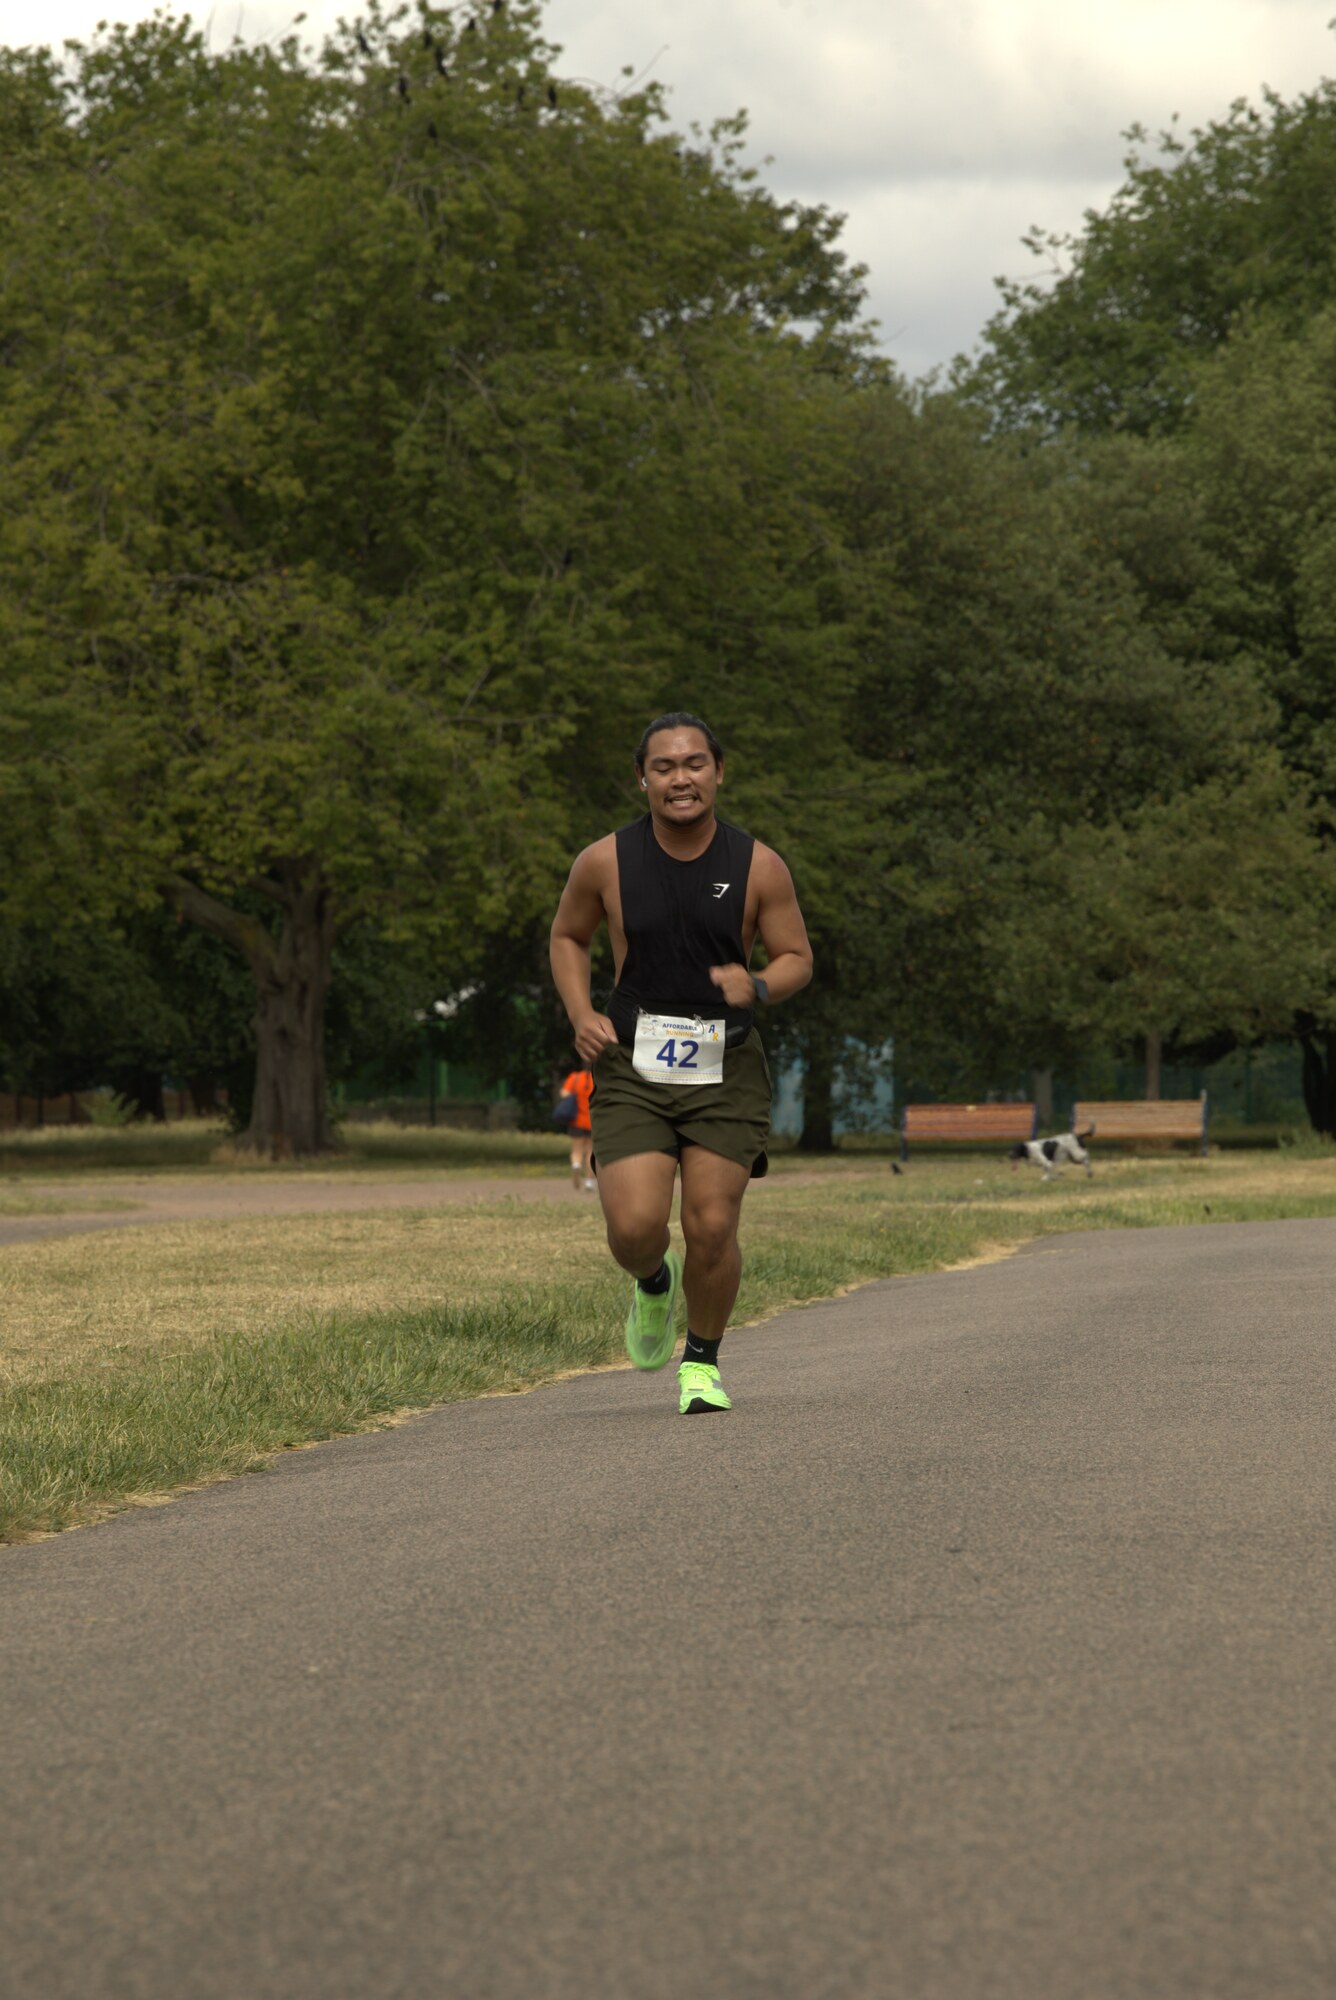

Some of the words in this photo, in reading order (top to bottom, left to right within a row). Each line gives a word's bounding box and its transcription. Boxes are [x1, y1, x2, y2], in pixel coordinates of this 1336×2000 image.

[708, 1024, 716, 1034] A
[712, 1032, 719, 1042] R
[656, 1039, 699, 1068] 42
